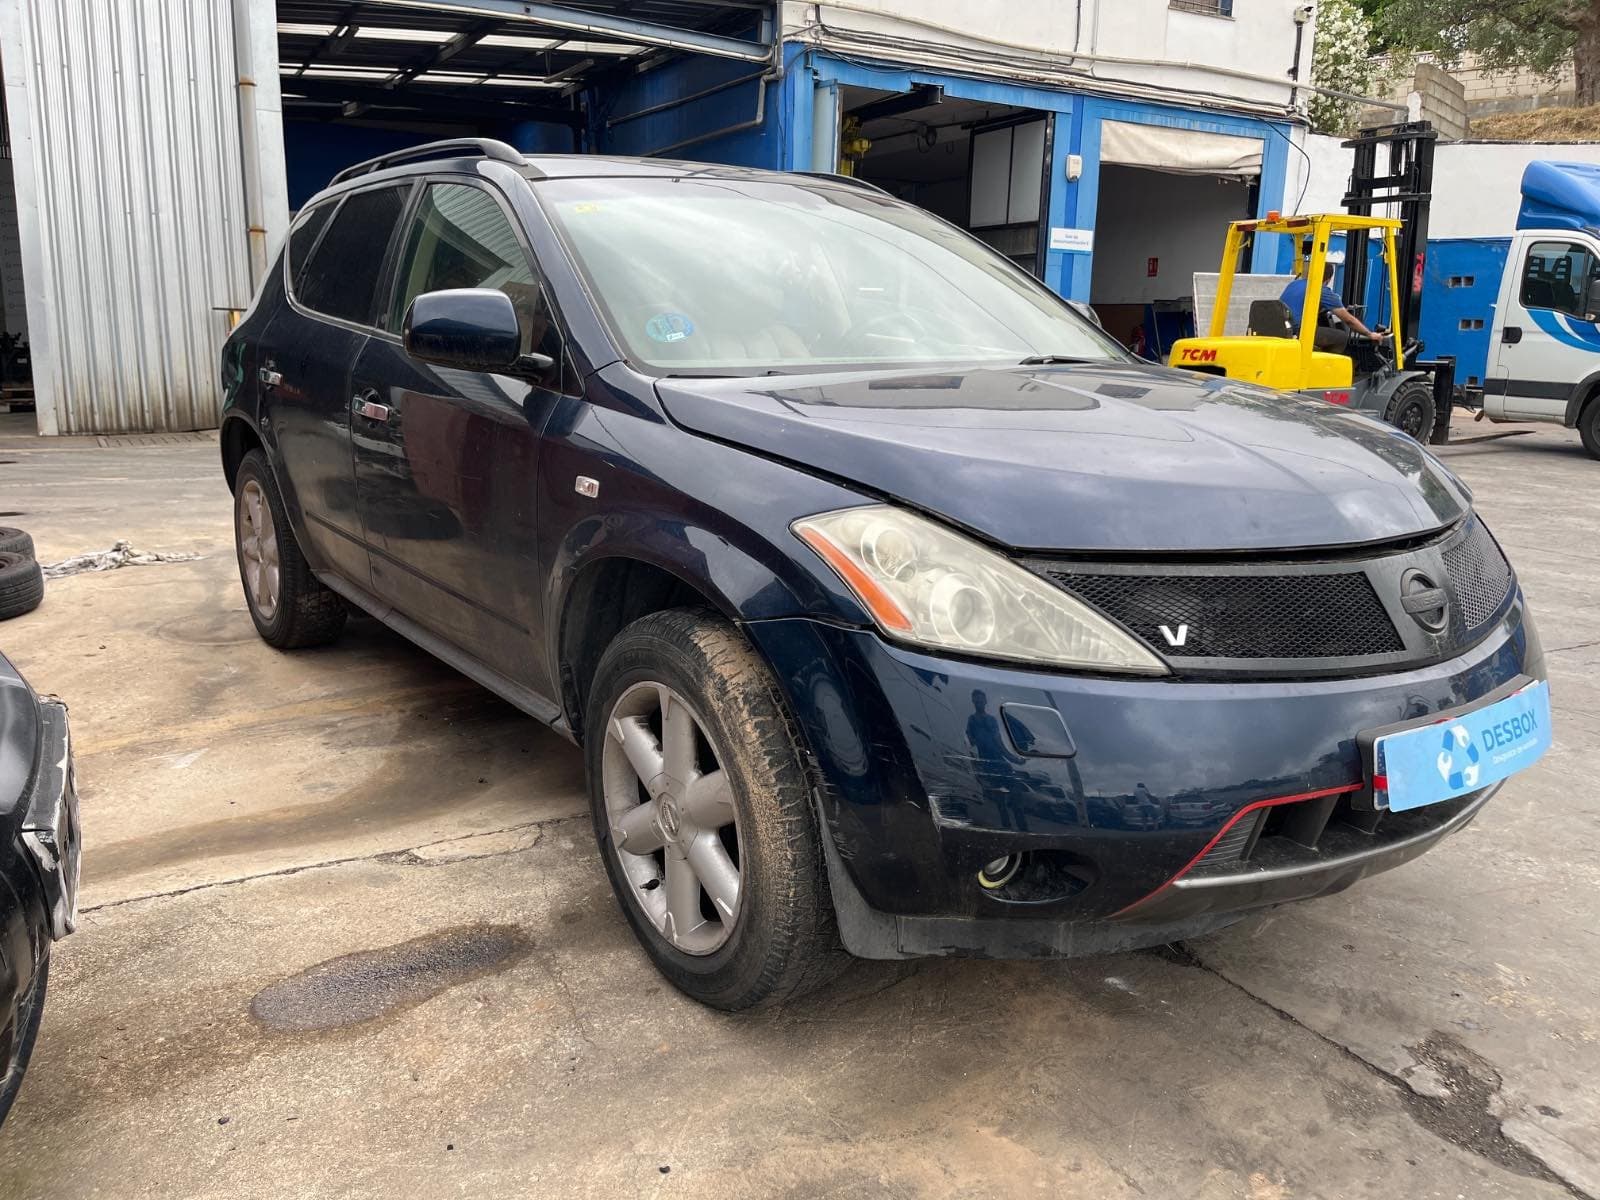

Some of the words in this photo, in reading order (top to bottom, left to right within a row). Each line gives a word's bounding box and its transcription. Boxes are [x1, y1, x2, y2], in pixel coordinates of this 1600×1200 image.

[1413, 252, 1425, 294] TCM
[1182, 349, 1217, 361] TCM
[1324, 391, 1351, 404] TCM
[1158, 624, 1188, 646] V
[1481, 708, 1538, 752] DESBOX
